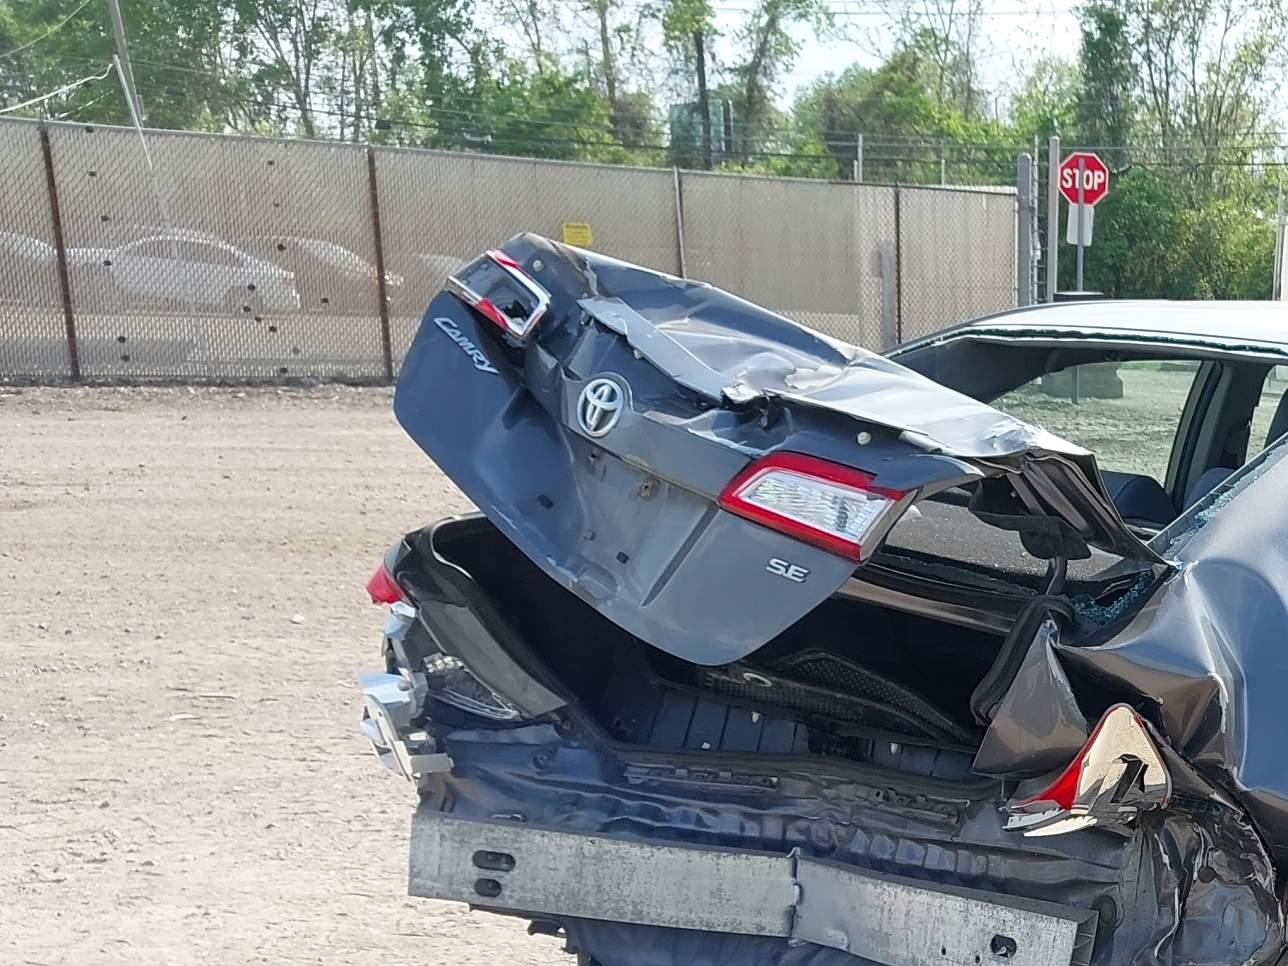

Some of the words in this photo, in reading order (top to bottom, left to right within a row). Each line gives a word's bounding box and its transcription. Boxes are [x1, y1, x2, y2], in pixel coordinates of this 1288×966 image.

[1062, 168, 1105, 191] STOP
[433, 317, 499, 374] CAMRY
[766, 558, 810, 583] SE
